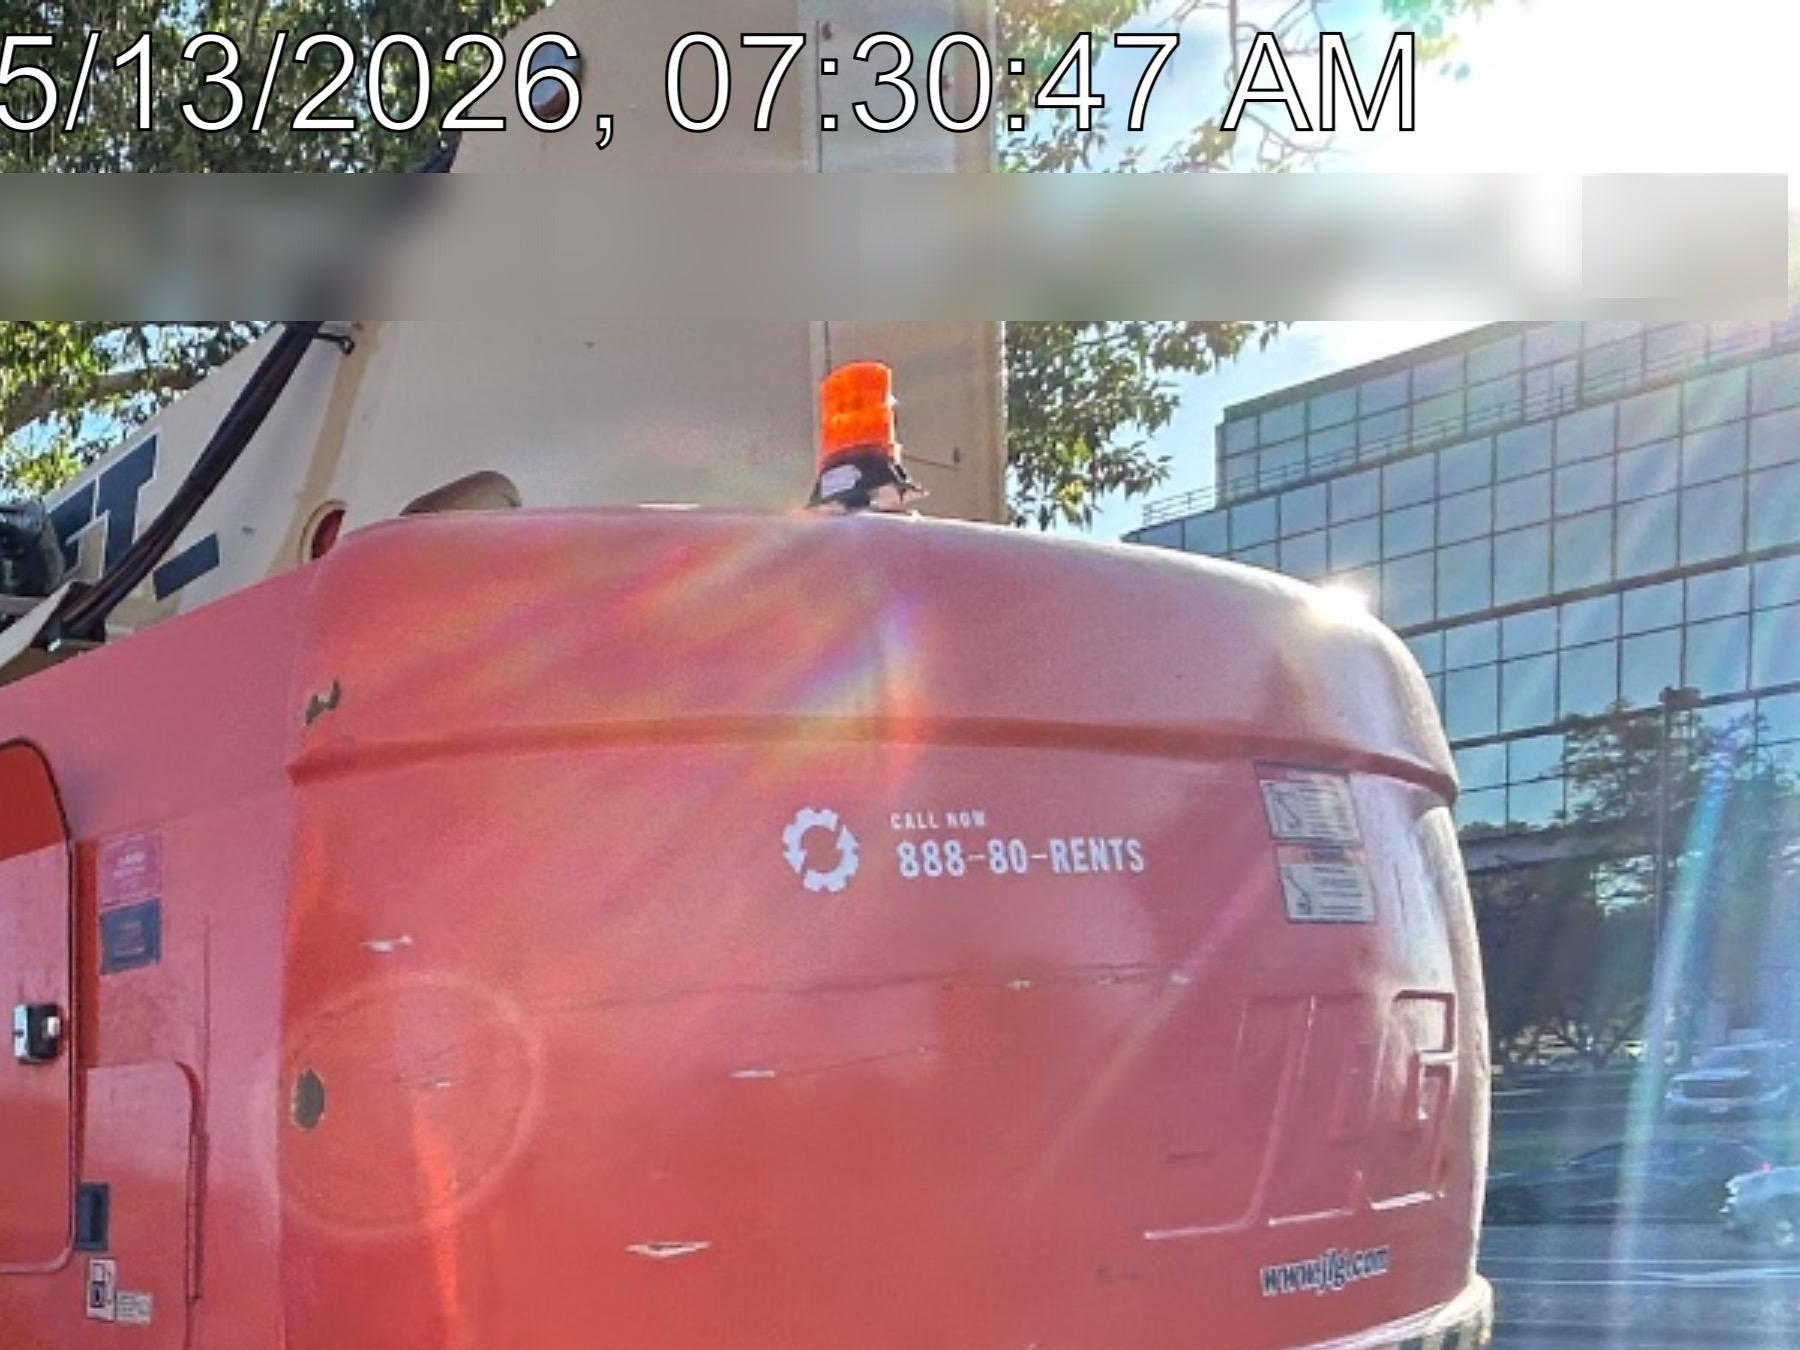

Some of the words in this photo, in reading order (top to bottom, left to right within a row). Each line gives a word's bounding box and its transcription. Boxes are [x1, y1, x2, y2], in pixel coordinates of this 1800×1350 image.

[890, 811, 940, 831] CALL
[947, 810, 987, 829] NOW
[897, 836, 1146, 879] 888-80-RENTS
